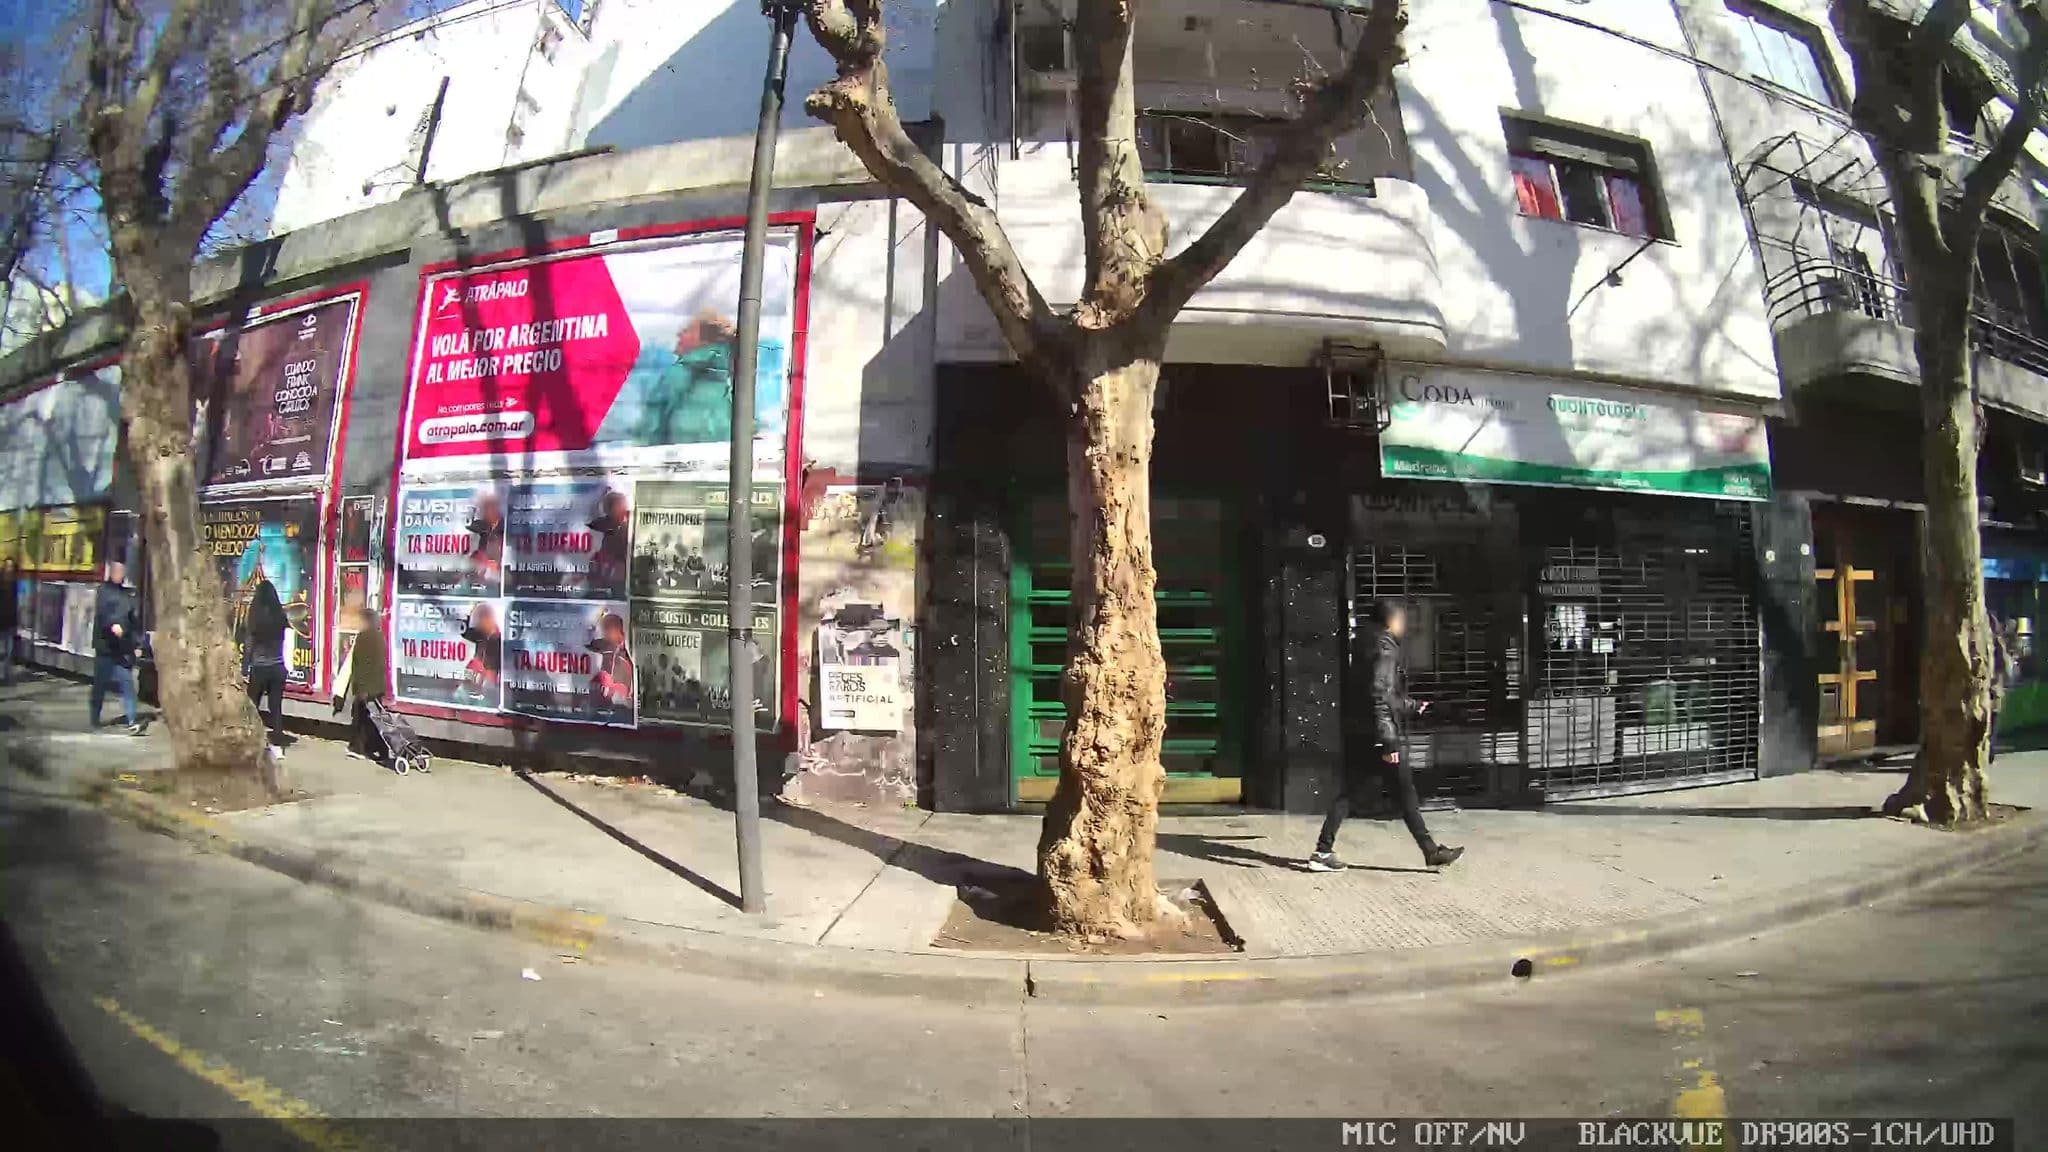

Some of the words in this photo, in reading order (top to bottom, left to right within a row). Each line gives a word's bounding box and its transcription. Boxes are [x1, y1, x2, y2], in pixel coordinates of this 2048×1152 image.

[465, 279, 529, 303] ATRÁPALO
[472, 328, 505, 352] POR
[507, 313, 607, 347] ARGENTINA
[425, 361, 443, 384] AL
[447, 354, 500, 381] MEJOR
[502, 348, 562, 376] PRECIO
[426, 420, 526, 439] atrapalo.com.ar
[407, 534, 422, 554] TA
[425, 534, 471, 555] BUENO
[536, 531, 592, 553] BUENO
[402, 638, 417, 657] TA
[420, 639, 467, 662] BUENO
[512, 648, 532, 672] TA
[535, 650, 592, 675] BUENO
